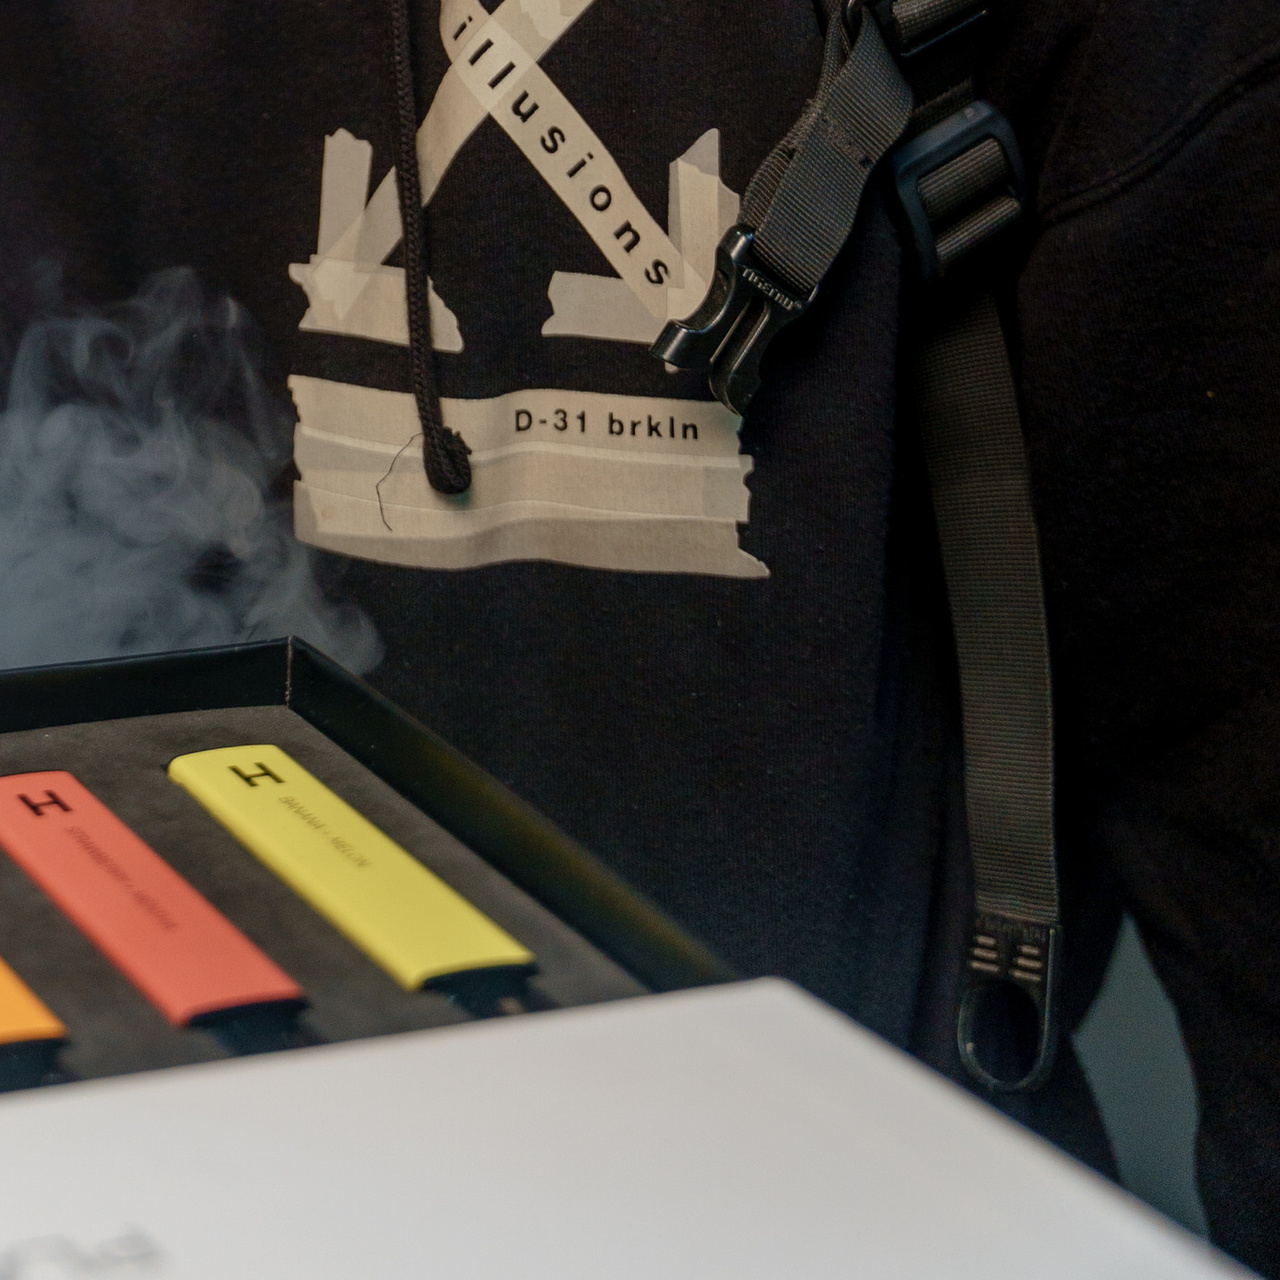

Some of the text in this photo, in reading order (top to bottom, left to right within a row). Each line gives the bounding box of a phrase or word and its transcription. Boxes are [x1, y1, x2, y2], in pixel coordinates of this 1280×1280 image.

[452, 15, 669, 286] illusions
[515, 408, 586, 433] D-31
[228, 761, 285, 787] H
[16, 789, 73, 816] H
